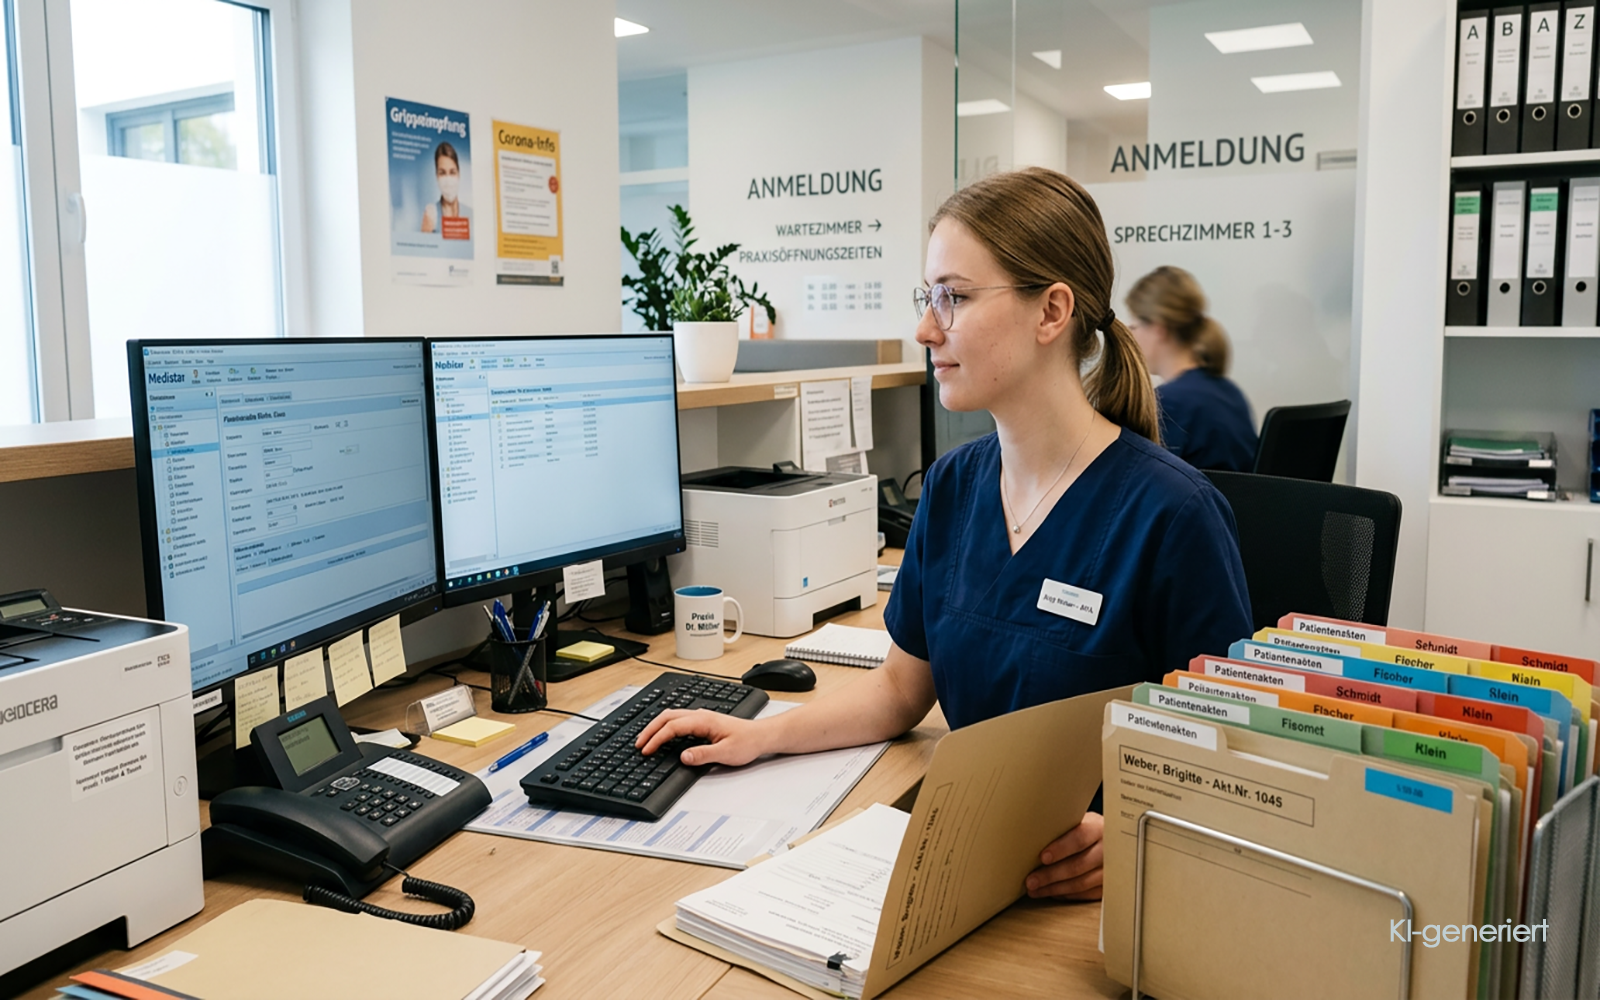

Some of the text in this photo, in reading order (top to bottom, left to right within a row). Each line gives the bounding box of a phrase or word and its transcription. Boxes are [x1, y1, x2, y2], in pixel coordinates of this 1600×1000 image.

[1502, 21, 1513, 36] B
[1537, 17, 1550, 33] A
[1573, 14, 1586, 29] Z
[1467, 25, 1479, 40] A
[1110, 132, 1305, 173] ANMELDUNG
[747, 168, 882, 200] ANMELDUNG
[776, 220, 862, 236] WARTEZIMMER
[1113, 220, 1293, 244] SPRECHZIMMER 1-3
[739, 246, 882, 263] PRAXISÖFFNUNGSZEITEN
[148, 371, 185, 384] Medistar
[1214, 664, 1284, 686] Patientenakten
[1124, 753, 1160, 775] Weber,
[1163, 764, 1203, 784] Brigitte
